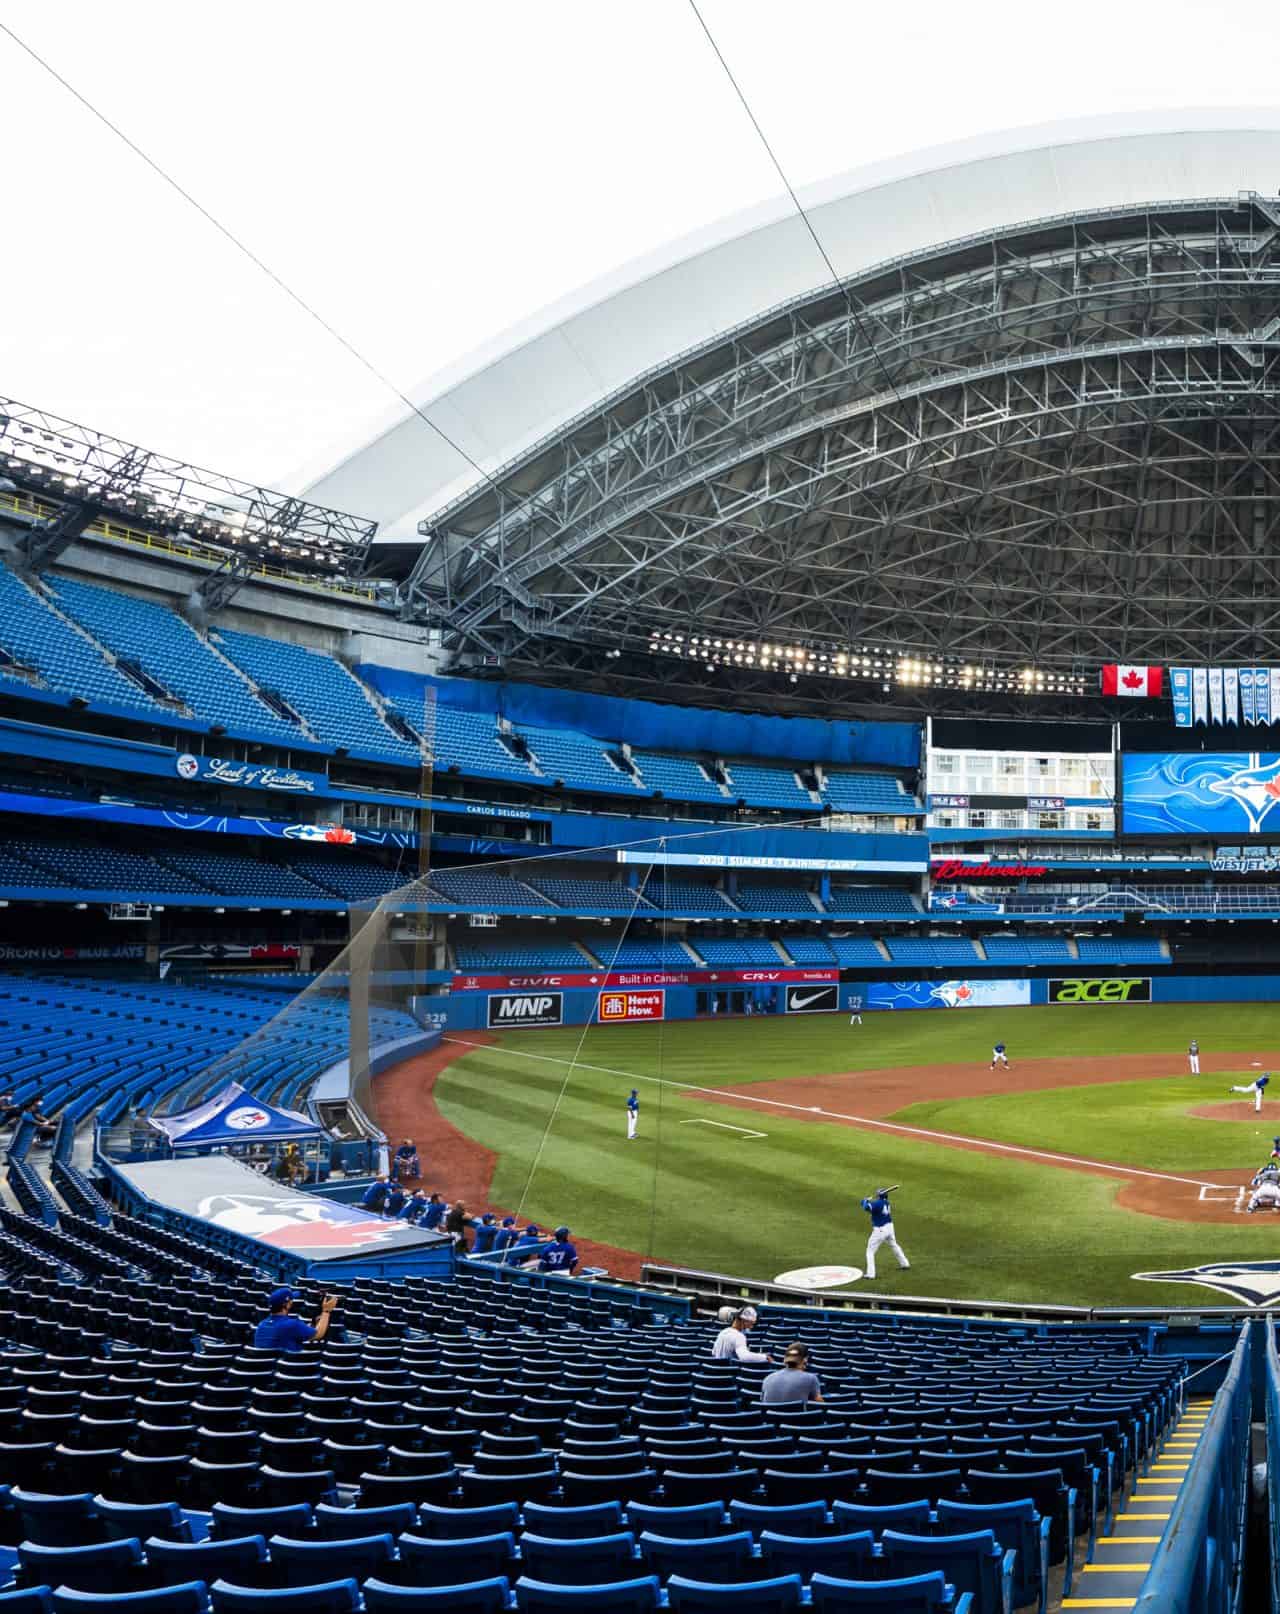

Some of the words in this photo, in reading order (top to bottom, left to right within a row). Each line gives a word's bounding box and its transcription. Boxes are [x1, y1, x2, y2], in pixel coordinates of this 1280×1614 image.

[466, 805, 495, 816] CARLOS
[932, 860, 1047, 879] Budweiser
[619, 974, 640, 984] Built
[643, 973, 652, 983] in
[653, 972, 689, 984] Canada
[742, 972, 780, 980] CR-V
[509, 977, 563, 987] CIVIC
[1056, 980, 1142, 1002] acer
[628, 995, 660, 1005] Here's
[499, 997, 553, 1017] MNP
[628, 1006, 654, 1016] How.
[424, 1013, 447, 1023] 328
[548, 1251, 565, 1264] 37
